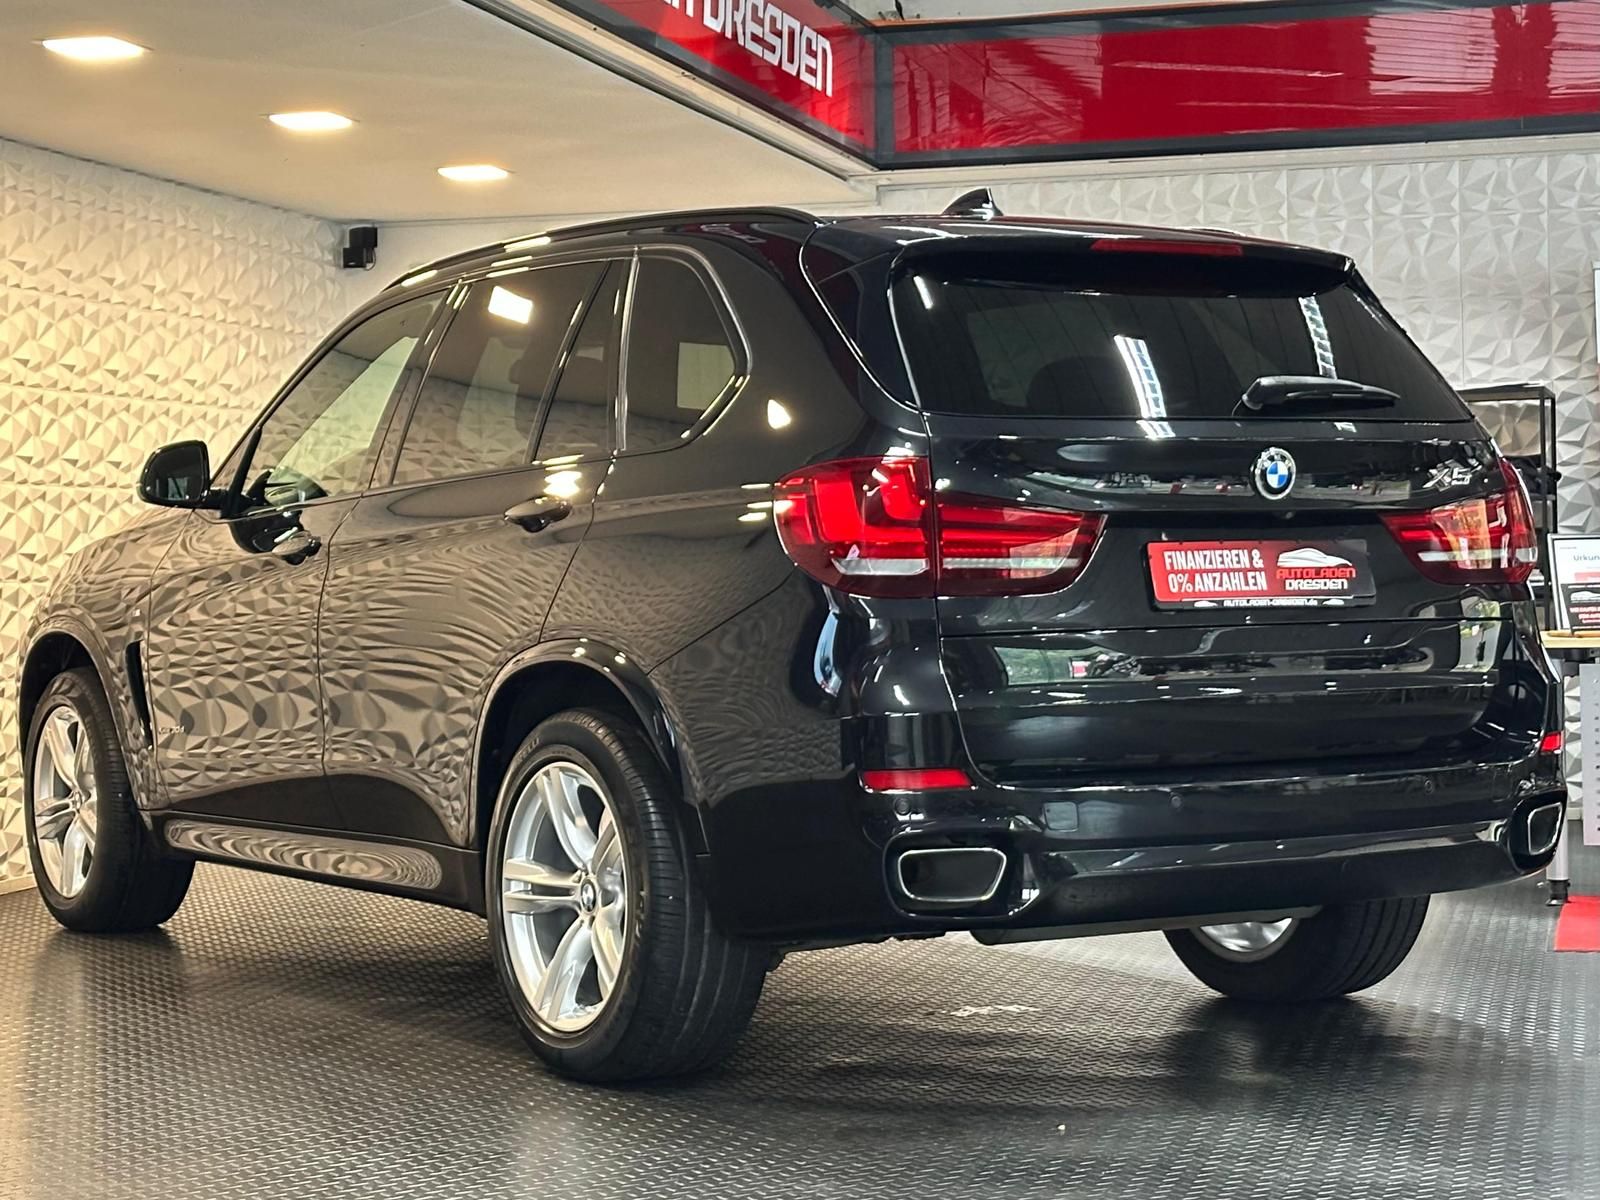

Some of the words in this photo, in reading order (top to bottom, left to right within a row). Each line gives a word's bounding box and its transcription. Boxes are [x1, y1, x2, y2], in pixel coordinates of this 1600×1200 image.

[1422, 459, 1473, 492] X5
[1163, 549, 1250, 570] FINANZIEREN
[1251, 548, 1264, 568] &
[1167, 573, 1193, 593] 0%
[1194, 571, 1268, 592] ANZAHLEN
[1276, 567, 1356, 579] AUTOLADEN
[1284, 579, 1348, 590] DRESDEN
